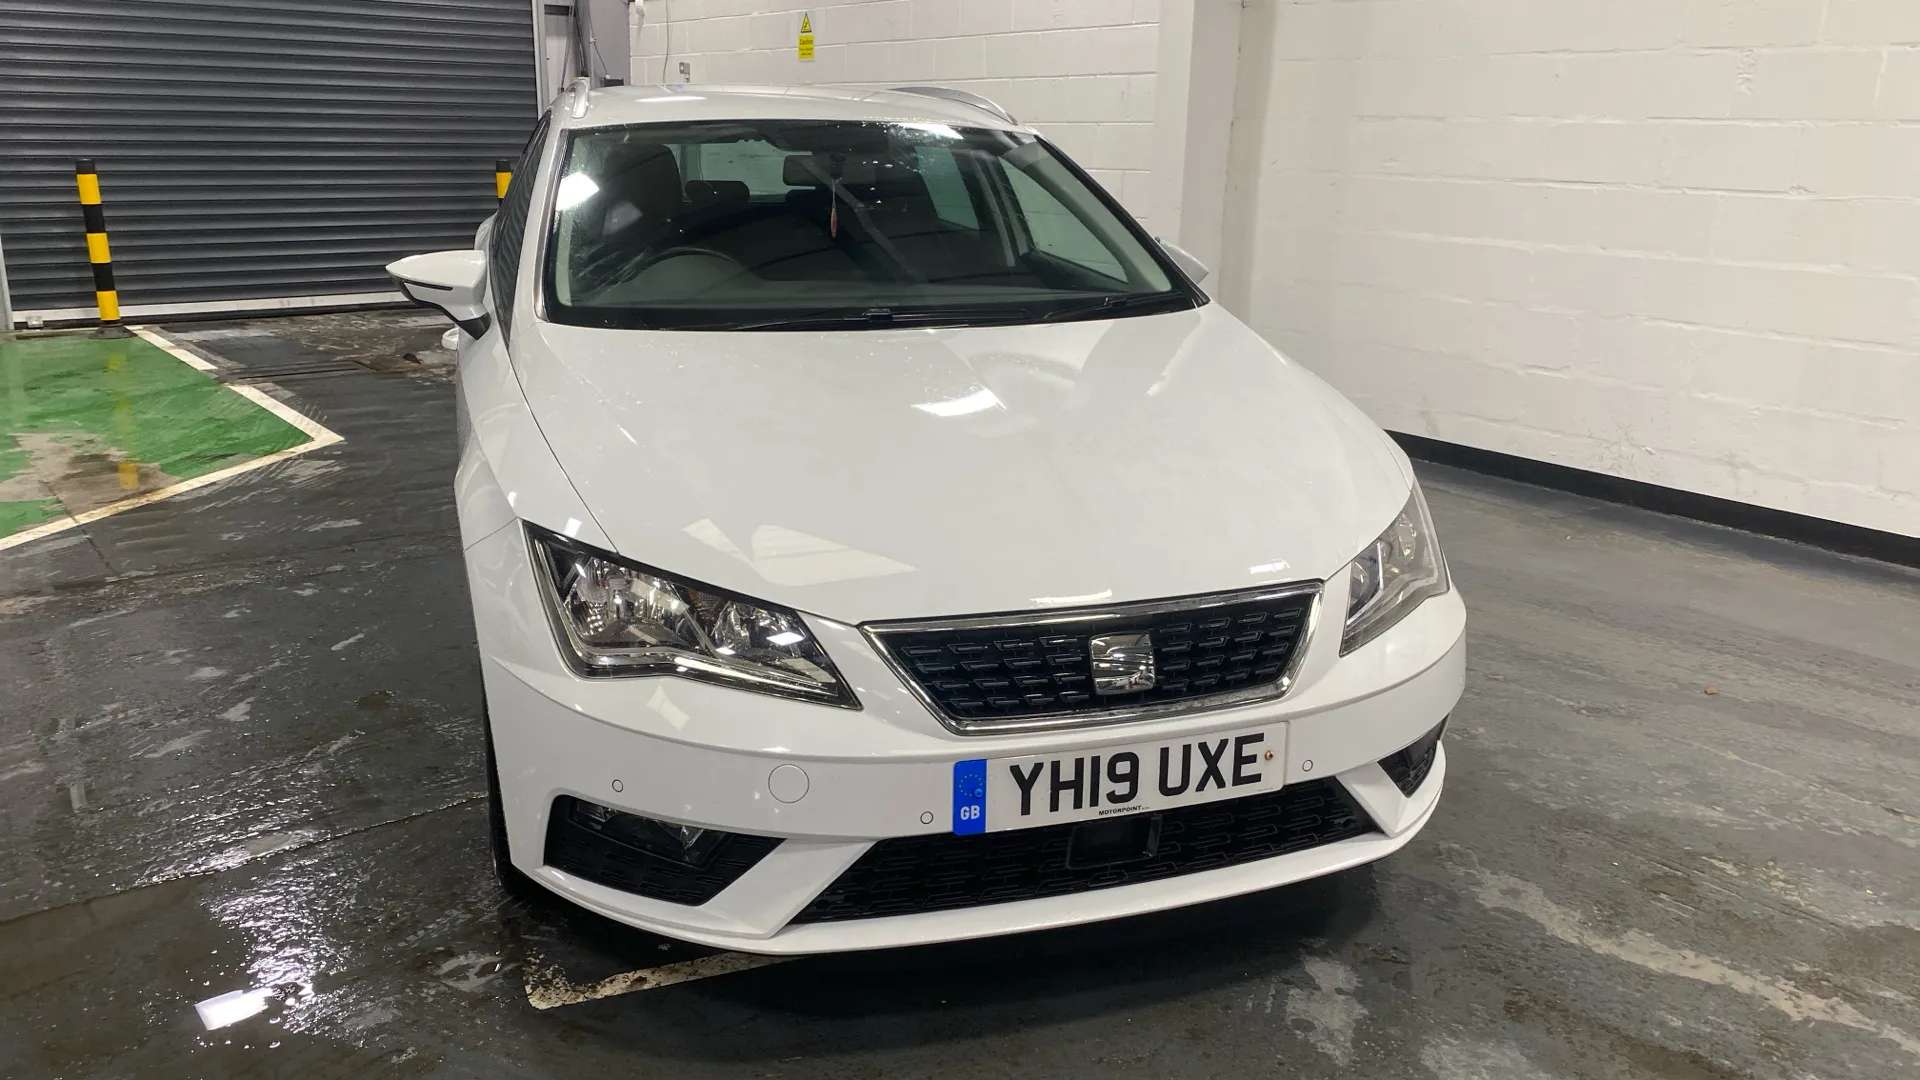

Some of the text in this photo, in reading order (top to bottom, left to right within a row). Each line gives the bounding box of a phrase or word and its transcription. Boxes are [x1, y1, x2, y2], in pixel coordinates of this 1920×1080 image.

[1008, 732, 1265, 817] YH19 UXE
[959, 805, 980, 821] GB
